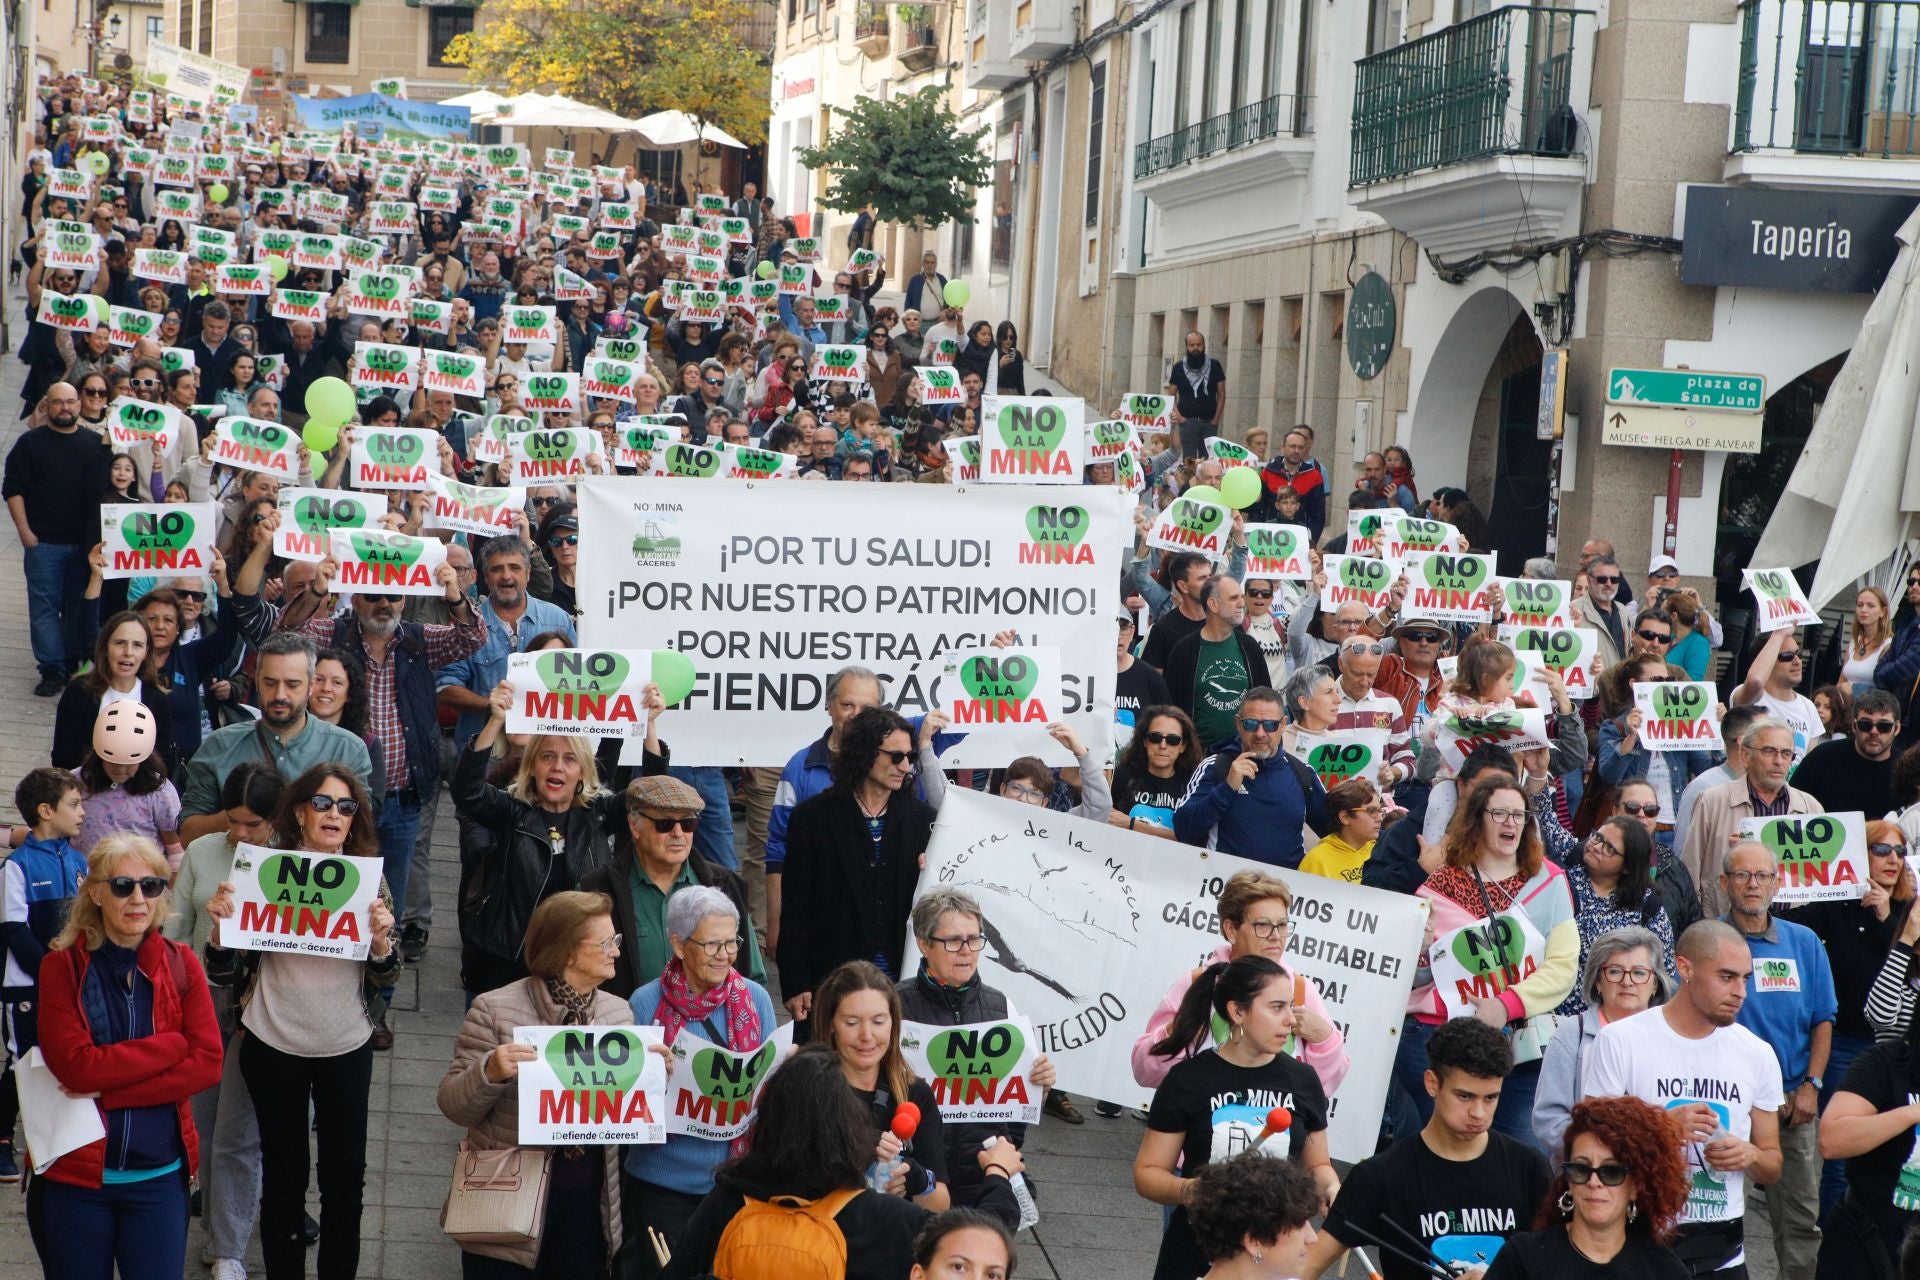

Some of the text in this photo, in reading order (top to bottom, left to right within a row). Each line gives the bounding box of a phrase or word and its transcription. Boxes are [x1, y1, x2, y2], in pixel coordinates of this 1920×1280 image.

[493, 148, 513, 159] NO
[167, 158, 186, 168] NO
[159, 171, 190, 182] MINA
[611, 206, 627, 215] NO
[604, 217, 631, 226] MINA
[63, 235, 87, 245] NO
[1752, 220, 1851, 260] Tapería
[52, 251, 94, 264] MINA
[222, 278, 263, 291] MINA
[367, 275, 394, 289] NO
[58, 298, 83, 311] NO
[353, 296, 401, 313] MINA
[696, 293, 716, 303] NO
[279, 303, 320, 318] MINA
[517, 310, 541, 321] NO
[687, 308, 721, 318] MINA
[44, 312, 89, 328] MINA
[509, 328, 551, 339] MINA
[373, 348, 400, 364] NO
[442, 355, 470, 369] NO
[830, 349, 852, 360] NO
[358, 368, 410, 386] MINA
[601, 362, 627, 377] NO
[818, 366, 858, 378] MINA
[931, 370, 948, 380] NO
[428, 371, 477, 392] MINA
[536, 376, 562, 390] NO
[587, 380, 631, 398] MINA
[1687, 377, 1757, 391] plaza de
[927, 388, 960, 399] MINA
[1136, 396, 1161, 409] NO
[1680, 391, 1756, 406] San Juan
[524, 397, 573, 409] MINA
[127, 403, 160, 424] NO
[1011, 406, 1057, 433] NO
[1124, 414, 1167, 428] MINA
[114, 427, 168, 449] MINA
[241, 423, 280, 442] NO
[1099, 422, 1125, 437] NO
[377, 434, 415, 453] NO
[533, 430, 568, 449] NO
[1655, 436, 1692, 446] HELGA
[1696, 437, 1711, 447] DE
[1715, 439, 1755, 449] ALVEAR
[219, 439, 288, 471] MINA
[675, 446, 713, 468] NO
[990, 448, 1073, 476] MINA
[360, 463, 427, 484] MINA
[520, 457, 581, 478] MINA
[456, 483, 501, 500] NO
[308, 497, 355, 522] NO
[435, 496, 514, 529] MINA
[1038, 506, 1080, 529] NO
[1181, 500, 1217, 522] NO
[135, 513, 184, 535] NO
[1406, 520, 1440, 533] NO
[139, 538, 172, 548] A LA
[1159, 523, 1218, 552] MINA
[1257, 529, 1290, 547] NO
[114, 548, 202, 570] MINA
[721, 535, 991, 572] ¡POR TU SALUD!
[1019, 543, 1095, 565] MINA
[341, 561, 432, 587] MINA
[1246, 557, 1302, 574] MINA
[1349, 559, 1383, 579] NO
[1435, 556, 1478, 577] NO
[608, 581, 1096, 618] ¡POR NUESTRO PATRIMONIO!
[1331, 586, 1391, 608] MINA
[1415, 588, 1490, 612] MINA
[1515, 582, 1553, 602] NO
[1505, 614, 1564, 627] MINA
[760, 631, 922, 660] NUESTRA
[1529, 630, 1572, 652] NO
[554, 652, 616, 676] NO
[975, 654, 1027, 682] NO
[557, 678, 600, 691] A LA
[978, 685, 1015, 696] A LA
[1114, 696, 1140, 708] MINA
[1663, 685, 1700, 706] NO
[525, 691, 638, 722] MINA
[954, 698, 1048, 724] MINA
[537, 723, 623, 735] ¡Defiende Cáceres!
[1647, 720, 1715, 740] MINA
[1319, 744, 1362, 763] NO
[1777, 818, 1833, 845] NO
[1783, 847, 1821, 860] A LA
[277, 856, 346, 889] NO
[939, 820, 1138, 933] Sierra de la Mosca
[277, 889, 324, 905] A LA
[1812, 890, 1847, 898] Cáceres!
[240, 901, 360, 942] MINA
[1346, 908, 1378, 935] UN
[251, 939, 344, 954] ¡Defiende Cáceres!
[1464, 919, 1512, 956] NO
[1285, 933, 1402, 979] ABITABLE!
[1768, 962, 1786, 971] NO
[1762, 977, 1796, 986] MINA
[564, 1032, 629, 1066] NO
[946, 1027, 1012, 1059] NO
[710, 1047, 764, 1084] NO
[946, 1062, 992, 1075] A LA
[572, 1070, 617, 1086] A LA
[1210, 1088, 1295, 1112] NO MINA
[1657, 1078, 1683, 1097] NO
[1693, 1078, 1741, 1104] MINA
[539, 1089, 654, 1125] MINA
[970, 1110, 1012, 1118] Cáceres!
[552, 1130, 639, 1140] ¡Defiende Cáceres!
[686, 1124, 733, 1139] ¡Defiende
[1420, 1211, 1449, 1237] NO
[1461, 1208, 1516, 1232] MINA
